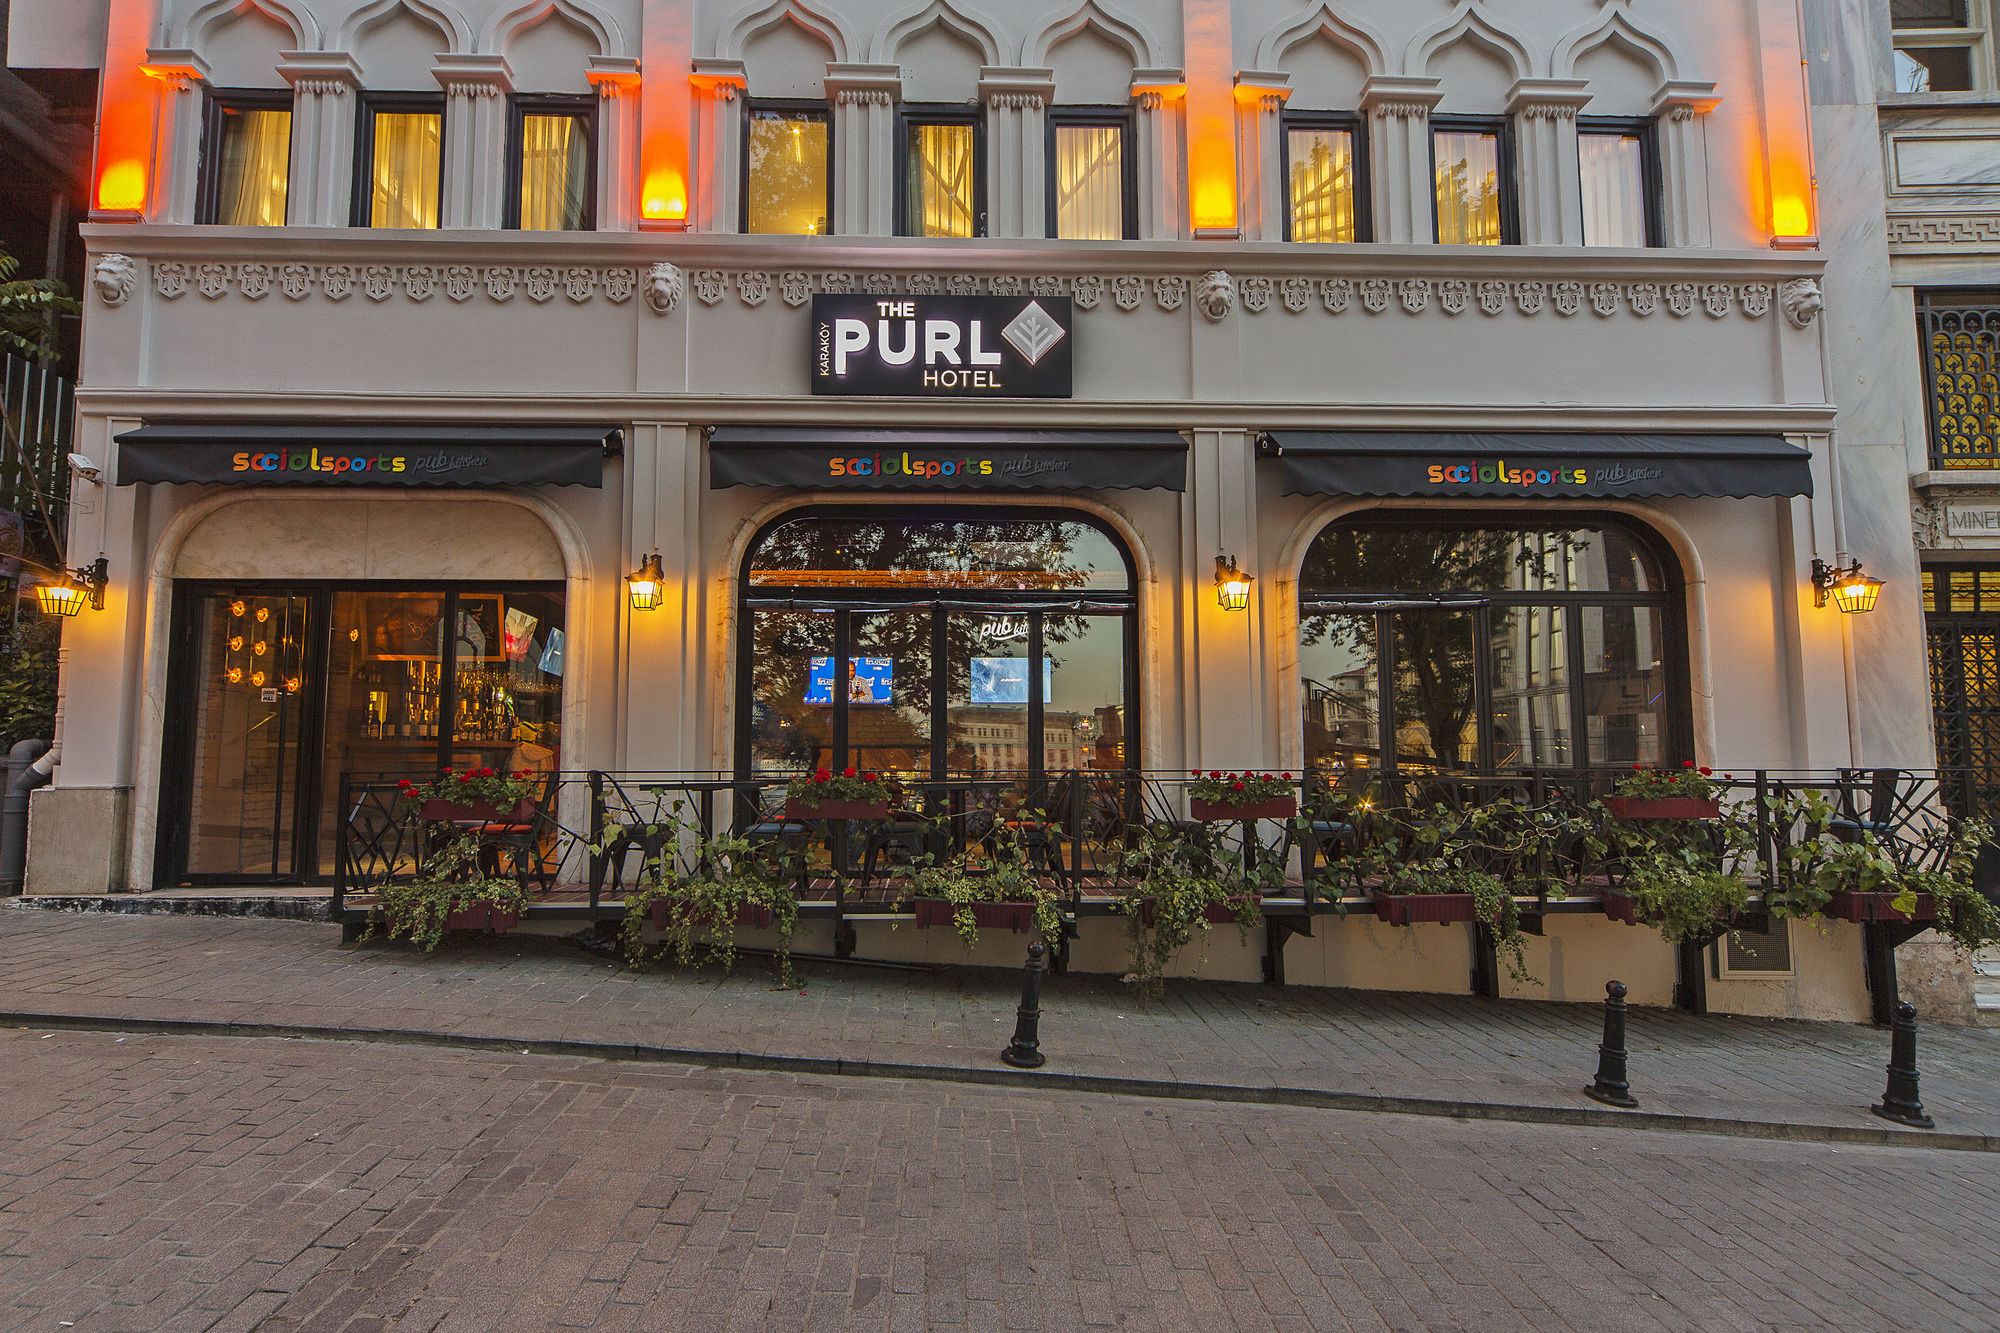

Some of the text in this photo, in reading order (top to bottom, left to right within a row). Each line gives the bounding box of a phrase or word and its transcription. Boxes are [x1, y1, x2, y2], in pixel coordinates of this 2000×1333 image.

[877, 301, 915, 317] THE
[819, 322, 830, 376] KARAKÖY
[835, 318, 1001, 375] PURL
[924, 370, 1001, 387] HOTEL
[412, 450, 447, 478] pub
[1000, 454, 1031, 478] pub
[1594, 462, 1626, 486] pub
[979, 616, 1012, 643] pub
